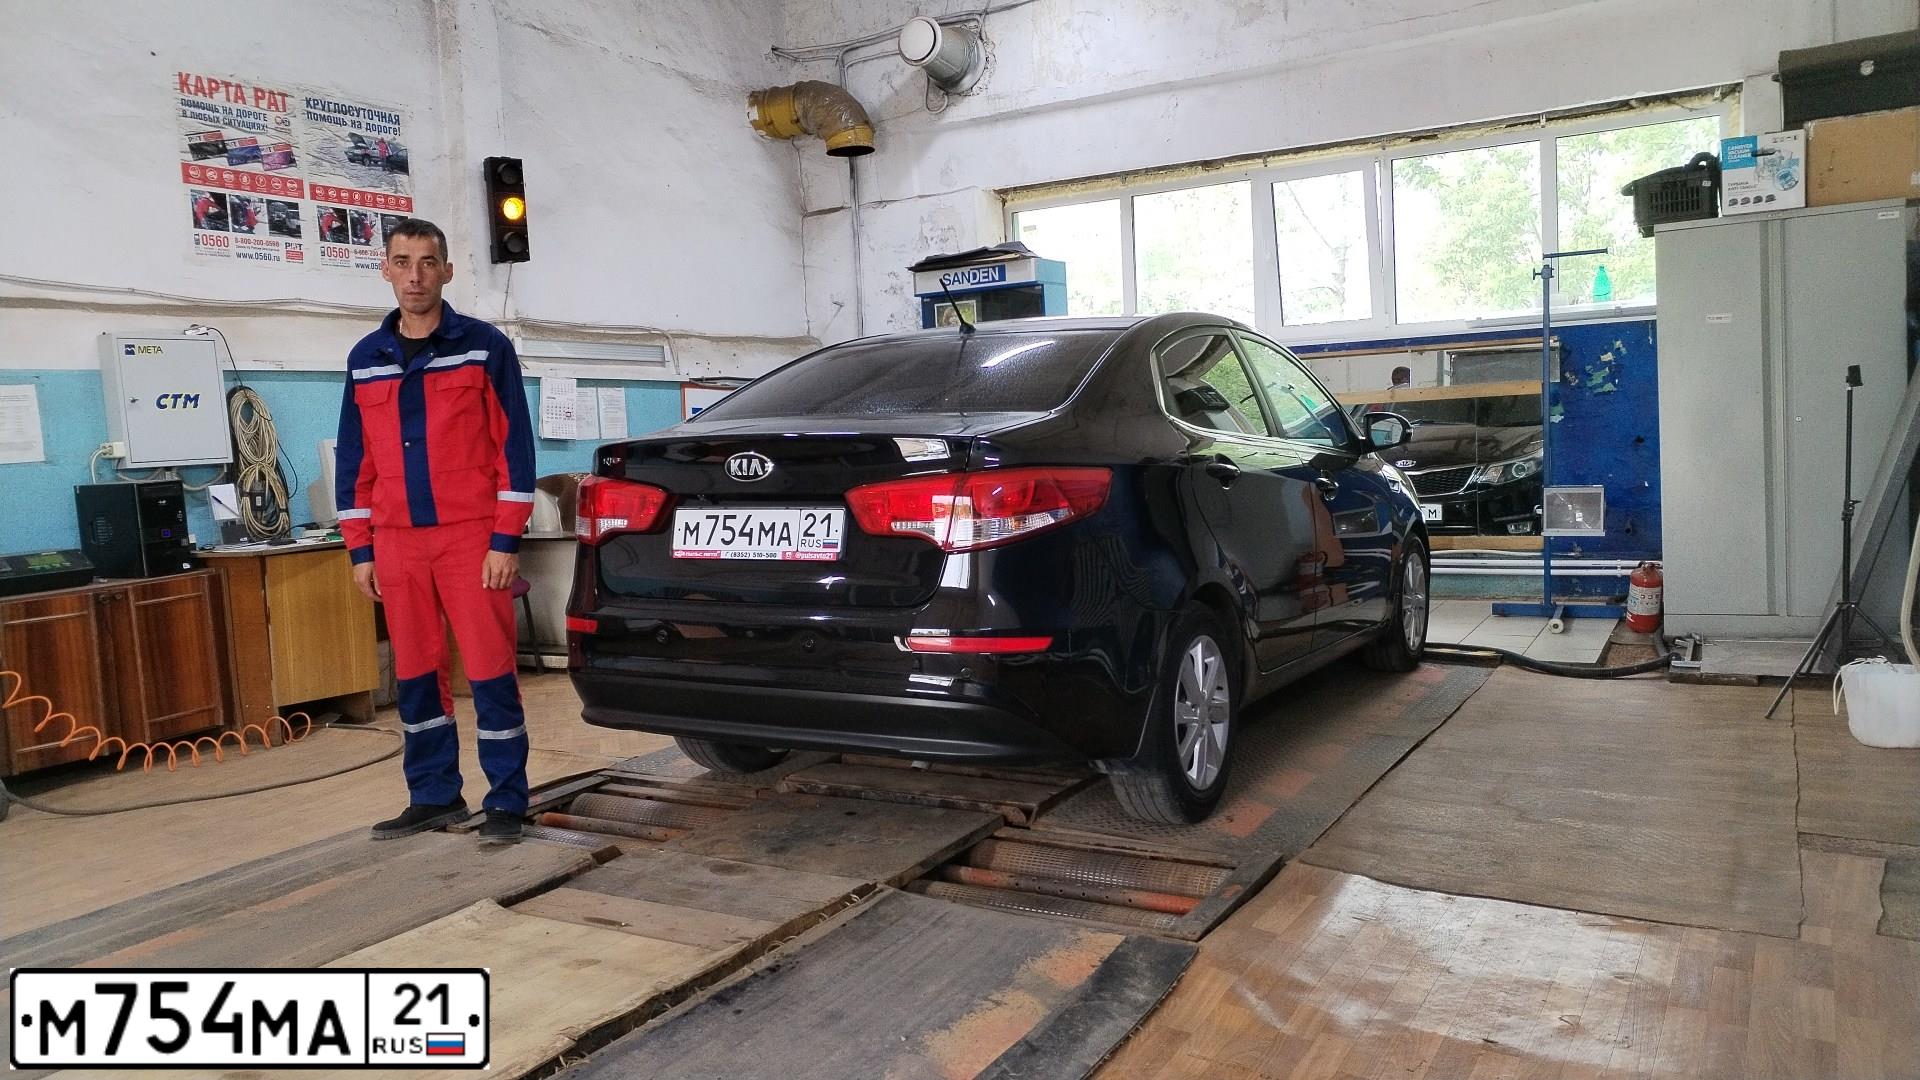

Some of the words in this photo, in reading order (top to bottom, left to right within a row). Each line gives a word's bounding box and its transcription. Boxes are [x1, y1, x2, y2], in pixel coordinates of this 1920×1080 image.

[178, 72, 246, 105] КАРТА
[253, 87, 289, 112] РАТ
[181, 98, 219, 114] ПОМОЩЬ
[222, 106, 234, 116] НА
[236, 108, 268, 121] ДОРОГЕ
[305, 97, 400, 125] КРУГЛОСУТОЧНАЯ
[190, 111, 220, 124] ЛЮБЫХ
[222, 117, 268, 132] СИТУАЦИЯХ!
[307, 111, 348, 127] помощь
[351, 119, 362, 129] на
[366, 122, 401, 137] дороге!
[201, 233, 230, 248] 0560
[236, 251, 281, 262] www.0560.ru
[326, 246, 350, 259] 0560
[943, 267, 999, 286] SANDEN
[730, 458, 764, 476] KIA
[683, 514, 792, 547] М754МА
[802, 513, 832, 538] 21
[800, 538, 822, 548] RUS
[730, 551, 751, 559] (8352)
